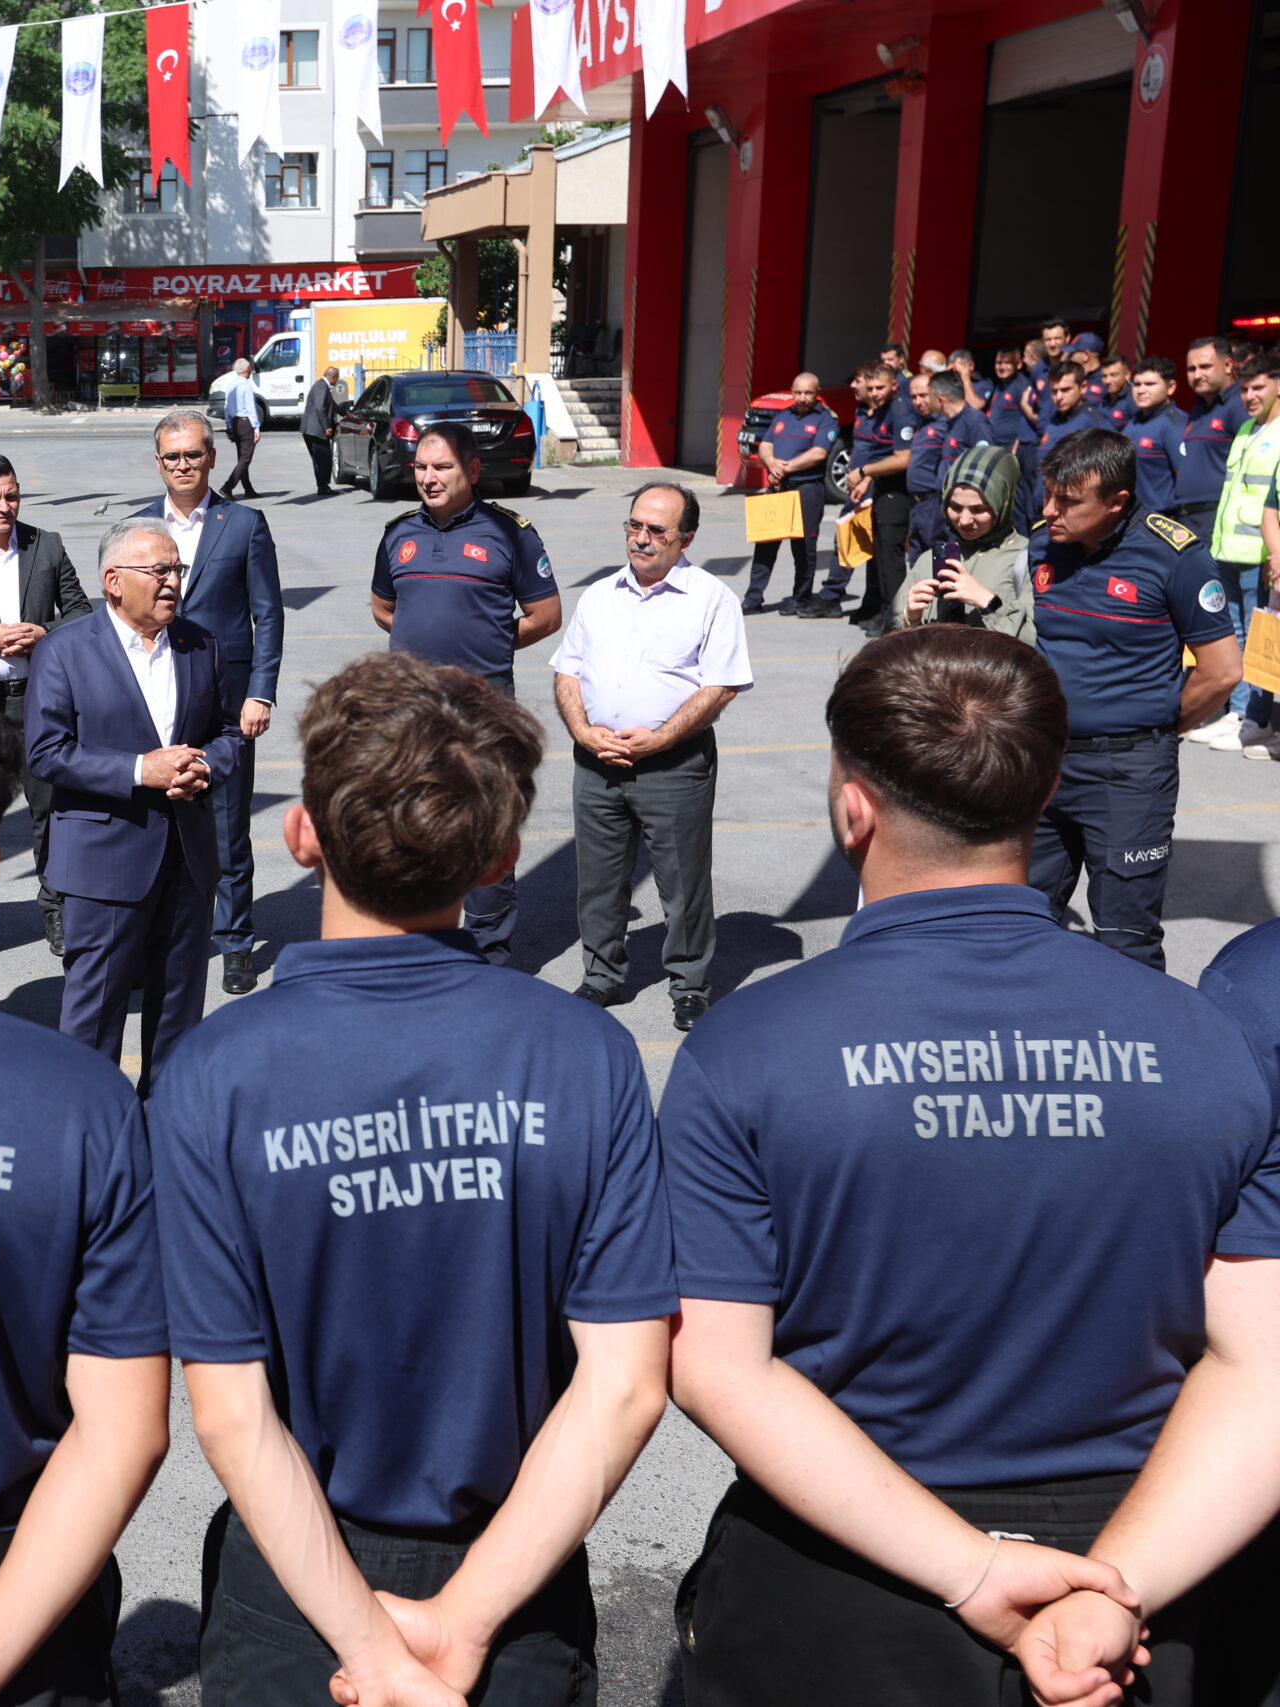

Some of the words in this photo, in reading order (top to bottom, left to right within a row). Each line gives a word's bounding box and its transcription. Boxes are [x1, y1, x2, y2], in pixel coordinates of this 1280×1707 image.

[153, 274, 262, 295] POYRAZ
[270, 270, 388, 294] MARKET
[328, 344, 397, 361] DENİNCE
[841, 1029, 1004, 1088] KAYSERİ
[1013, 1029, 1163, 1084] İTFAİYE
[263, 1098, 411, 1173] KAYSERİ
[912, 1093, 1106, 1139] STAJYER
[328, 1157, 504, 1218] STAJYER
